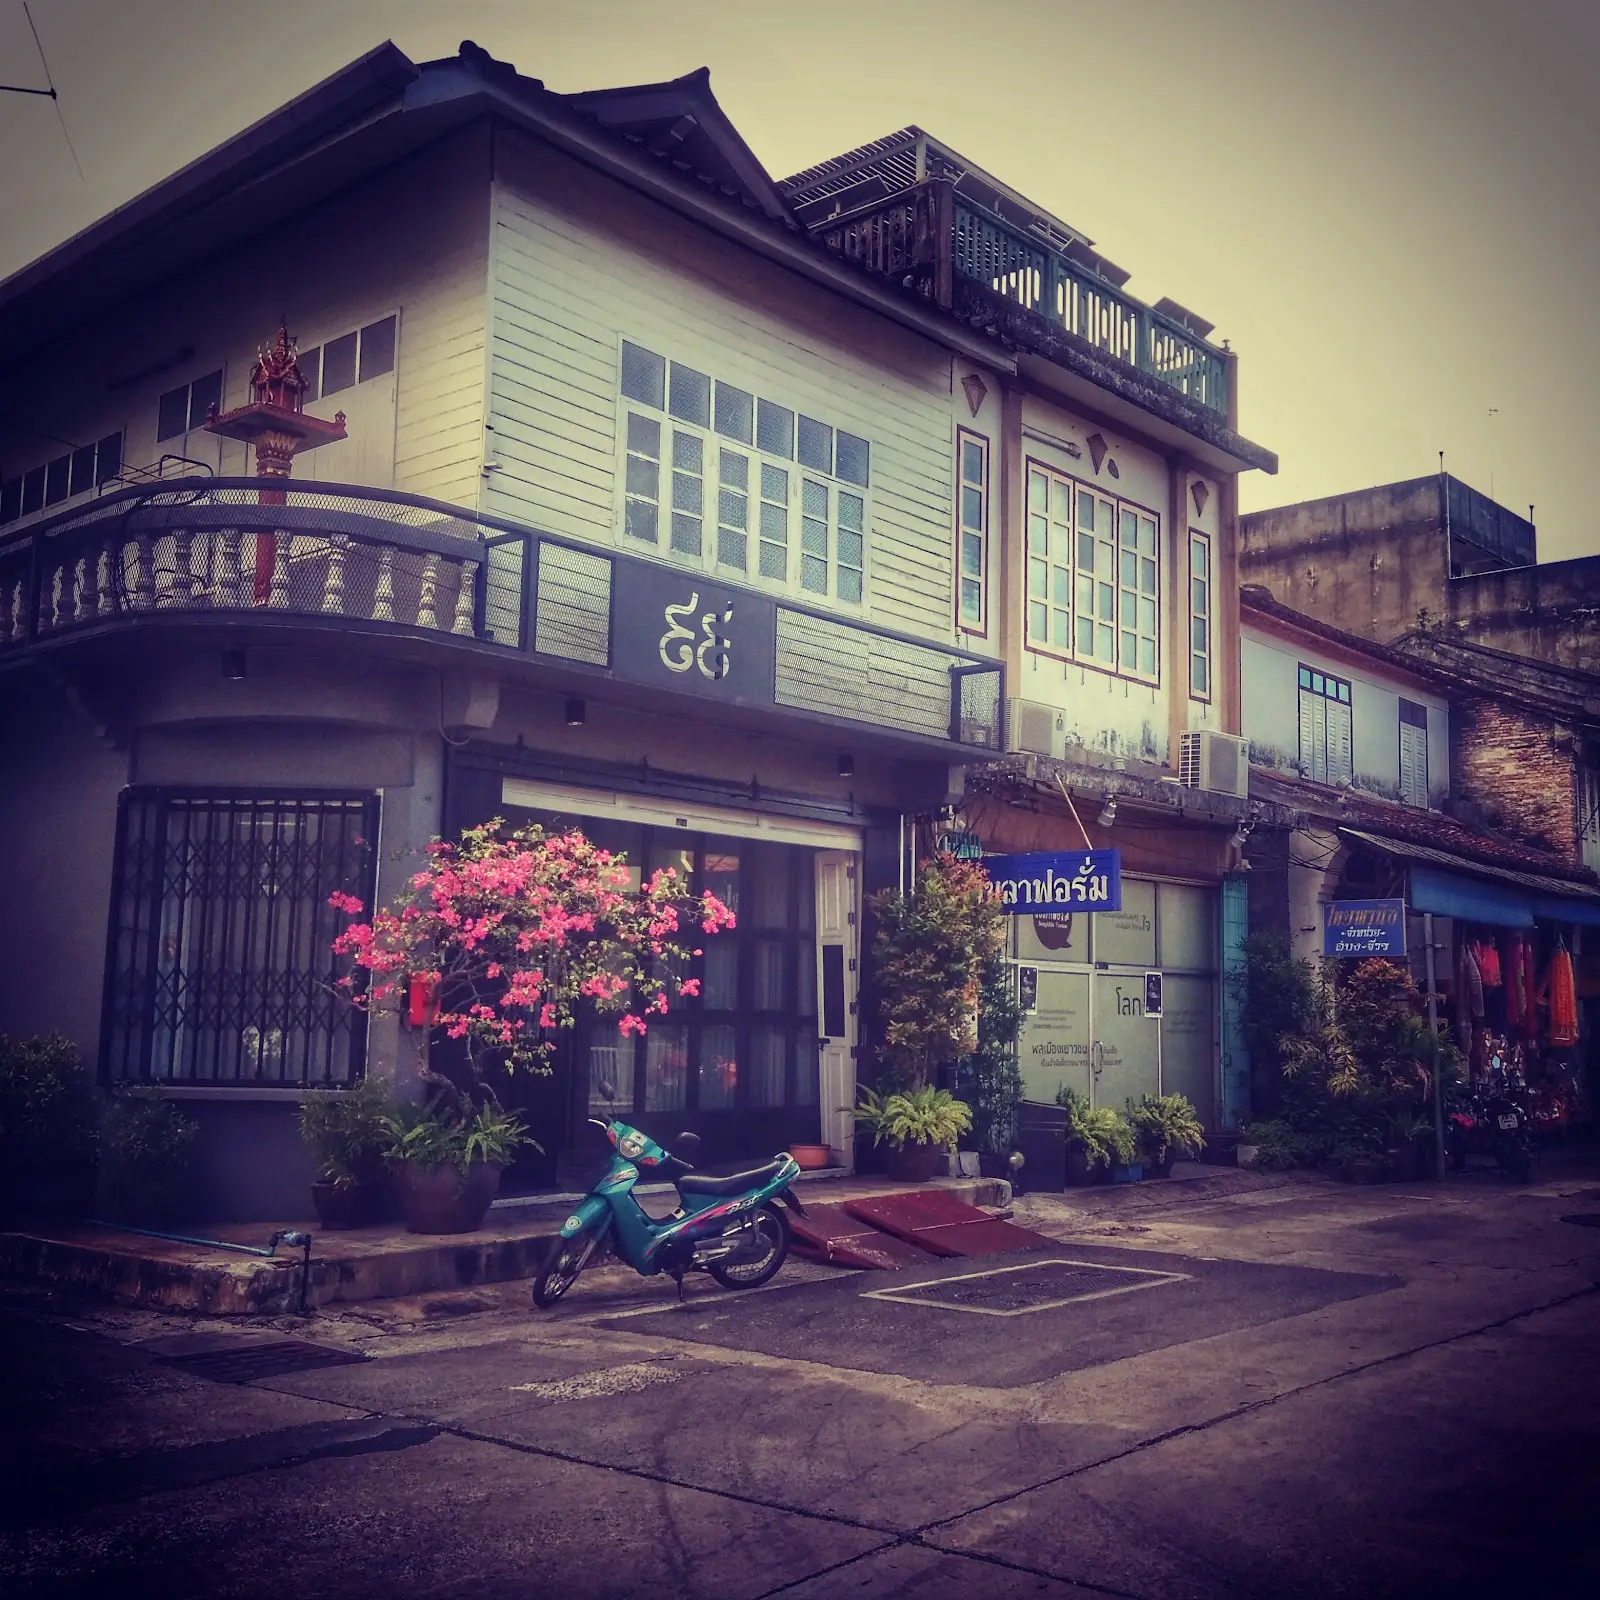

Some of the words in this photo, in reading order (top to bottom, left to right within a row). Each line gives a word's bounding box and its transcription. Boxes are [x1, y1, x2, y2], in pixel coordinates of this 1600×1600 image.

[978, 856, 1108, 904] ขลาฟอรั่ม
[1116, 986, 1143, 1015] โลก
